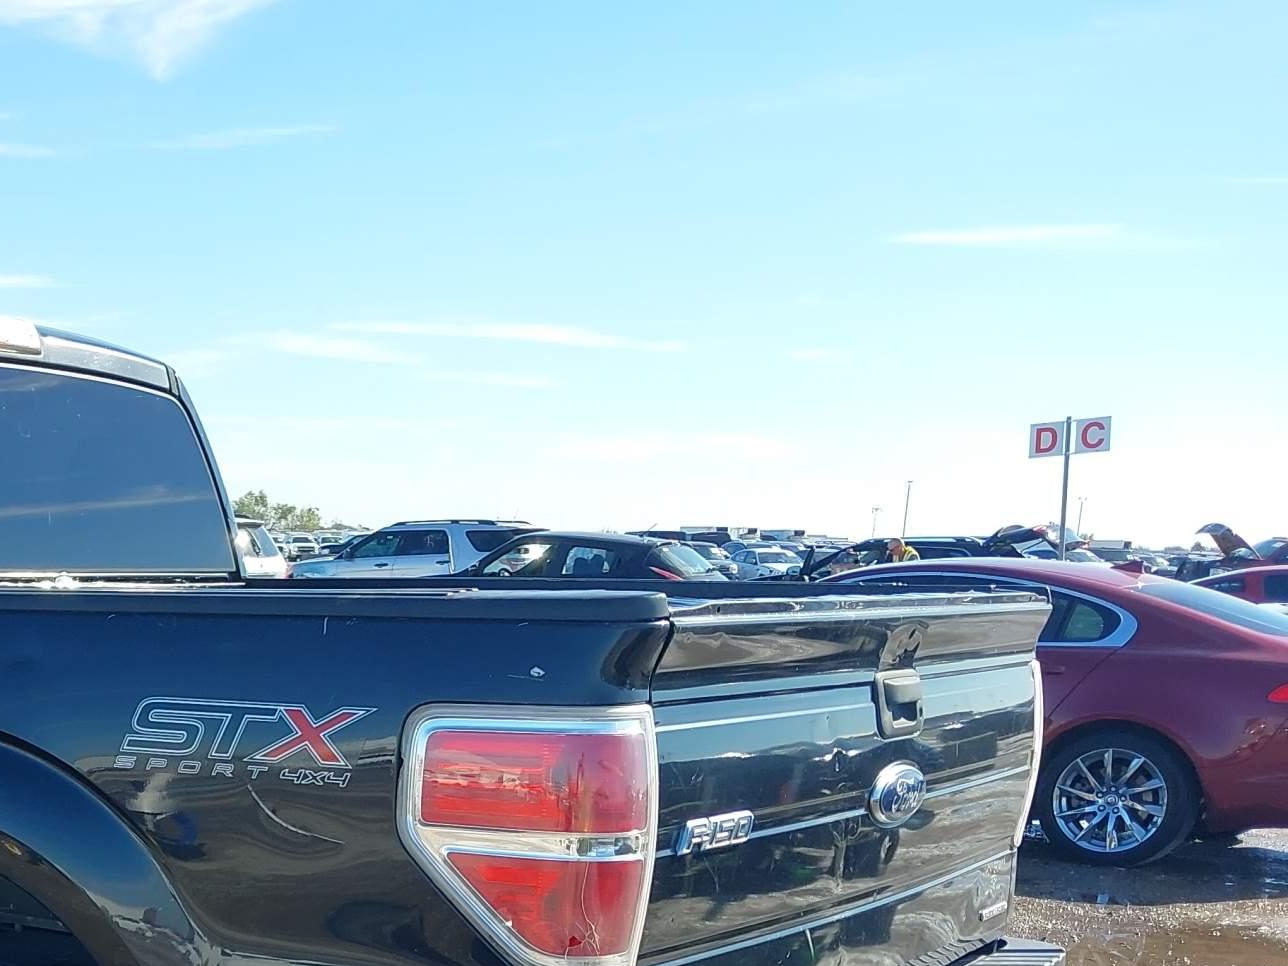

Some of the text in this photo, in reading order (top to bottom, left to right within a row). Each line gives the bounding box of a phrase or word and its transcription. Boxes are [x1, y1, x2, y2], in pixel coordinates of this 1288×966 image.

[1035, 426, 1058, 454] D
[1081, 421, 1106, 449] C
[120, 696, 379, 769] STX
[113, 755, 268, 780] SPORT
[892, 777, 923, 814] Ford
